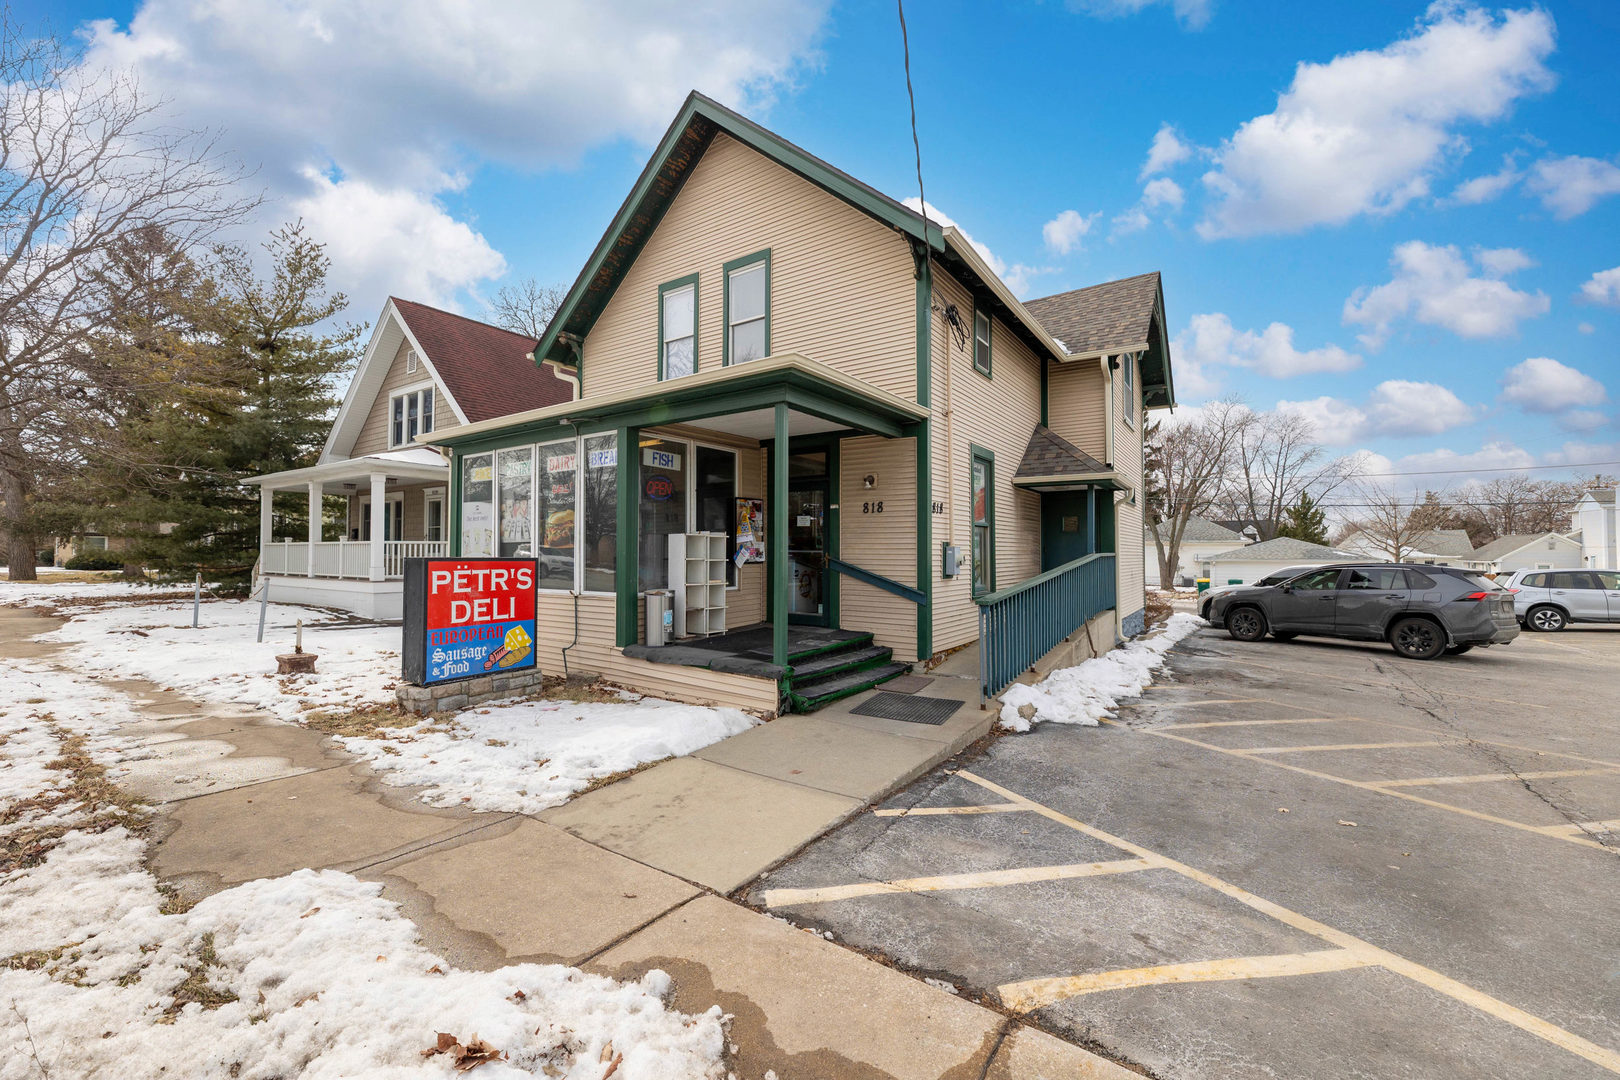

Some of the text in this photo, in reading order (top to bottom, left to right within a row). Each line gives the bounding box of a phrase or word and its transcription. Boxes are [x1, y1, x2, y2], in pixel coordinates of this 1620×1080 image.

[549, 455, 575, 472] DAIRY
[652, 451, 674, 468] FISH
[646, 480, 672, 496] OPEN
[862, 501, 884, 514] 818
[931, 502, 944, 514] 818
[431, 565, 533, 595] PËTR'S
[450, 597, 516, 624] DELI
[431, 625, 504, 646] EUROPEAN
[431, 646, 487, 664] Sausage
